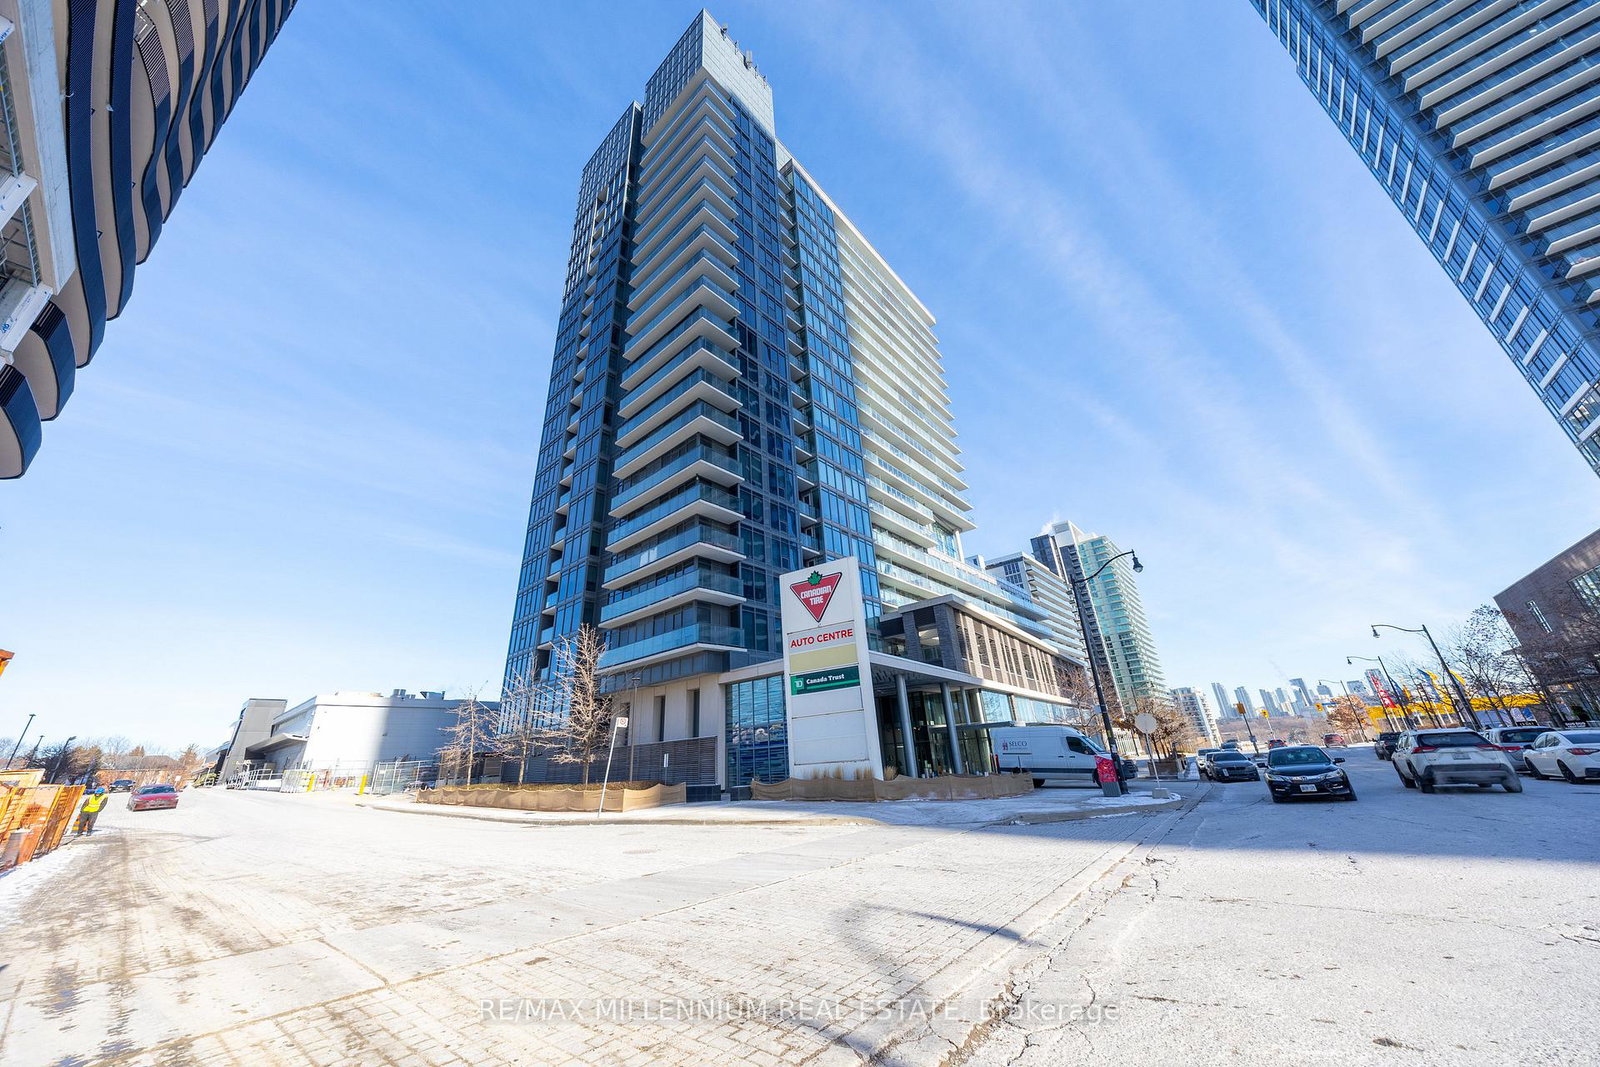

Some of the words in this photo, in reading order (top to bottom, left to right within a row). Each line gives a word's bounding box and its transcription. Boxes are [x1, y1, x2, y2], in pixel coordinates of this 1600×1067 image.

[800, 585, 831, 598] CANADIAN
[809, 596, 824, 606] TIRE
[790, 636, 814, 648] AUTO
[817, 629, 853, 643] CENTRE
[806, 676, 828, 685] Canada
[828, 673, 845, 681] Trust
